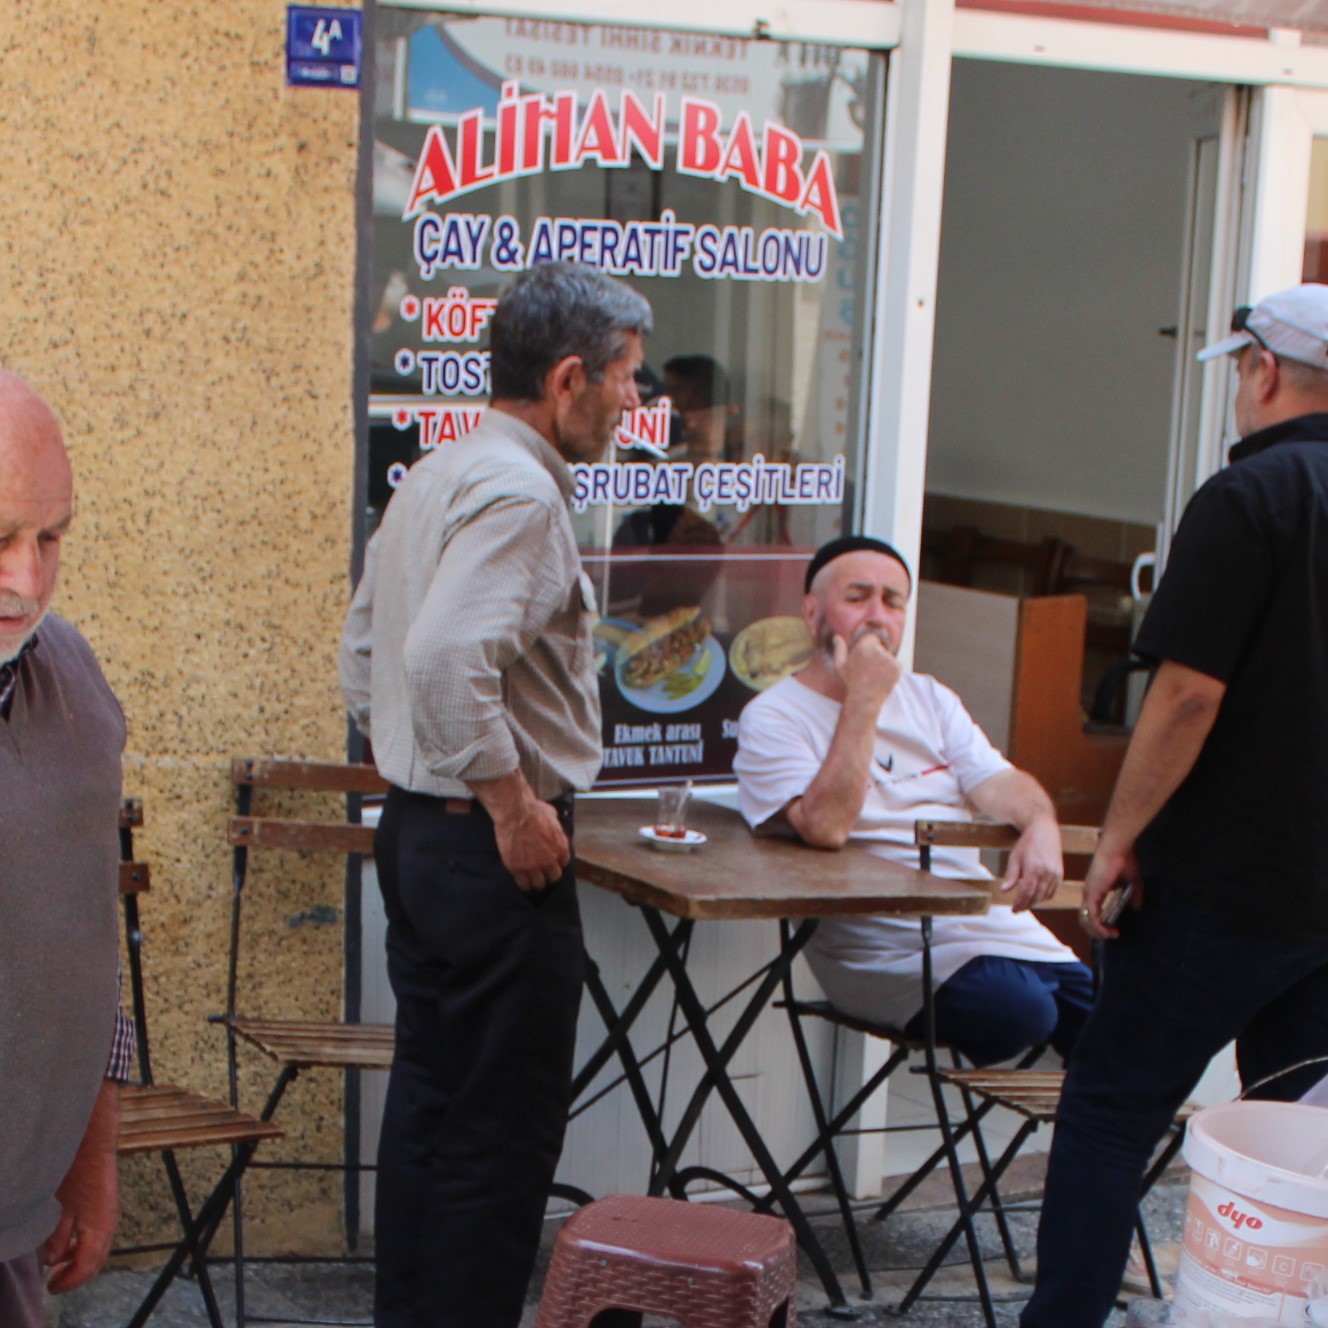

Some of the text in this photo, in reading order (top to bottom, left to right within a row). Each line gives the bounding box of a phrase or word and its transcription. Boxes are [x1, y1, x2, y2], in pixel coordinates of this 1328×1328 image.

[403, 82, 843, 240] ALİHAN BABA
[417, 215, 486, 278] ÇAY
[495, 215, 522, 270] &
[529, 211, 694, 277] APERATİF
[696, 227, 828, 281] SALONU
[696, 455, 845, 514] ÇEŞİTLERİ
[615, 724, 662, 744] Ekmek
[665, 724, 702, 742] arası
[649, 740, 703, 766] TANTUNİ
[1217, 1202, 1262, 1230] dyo
